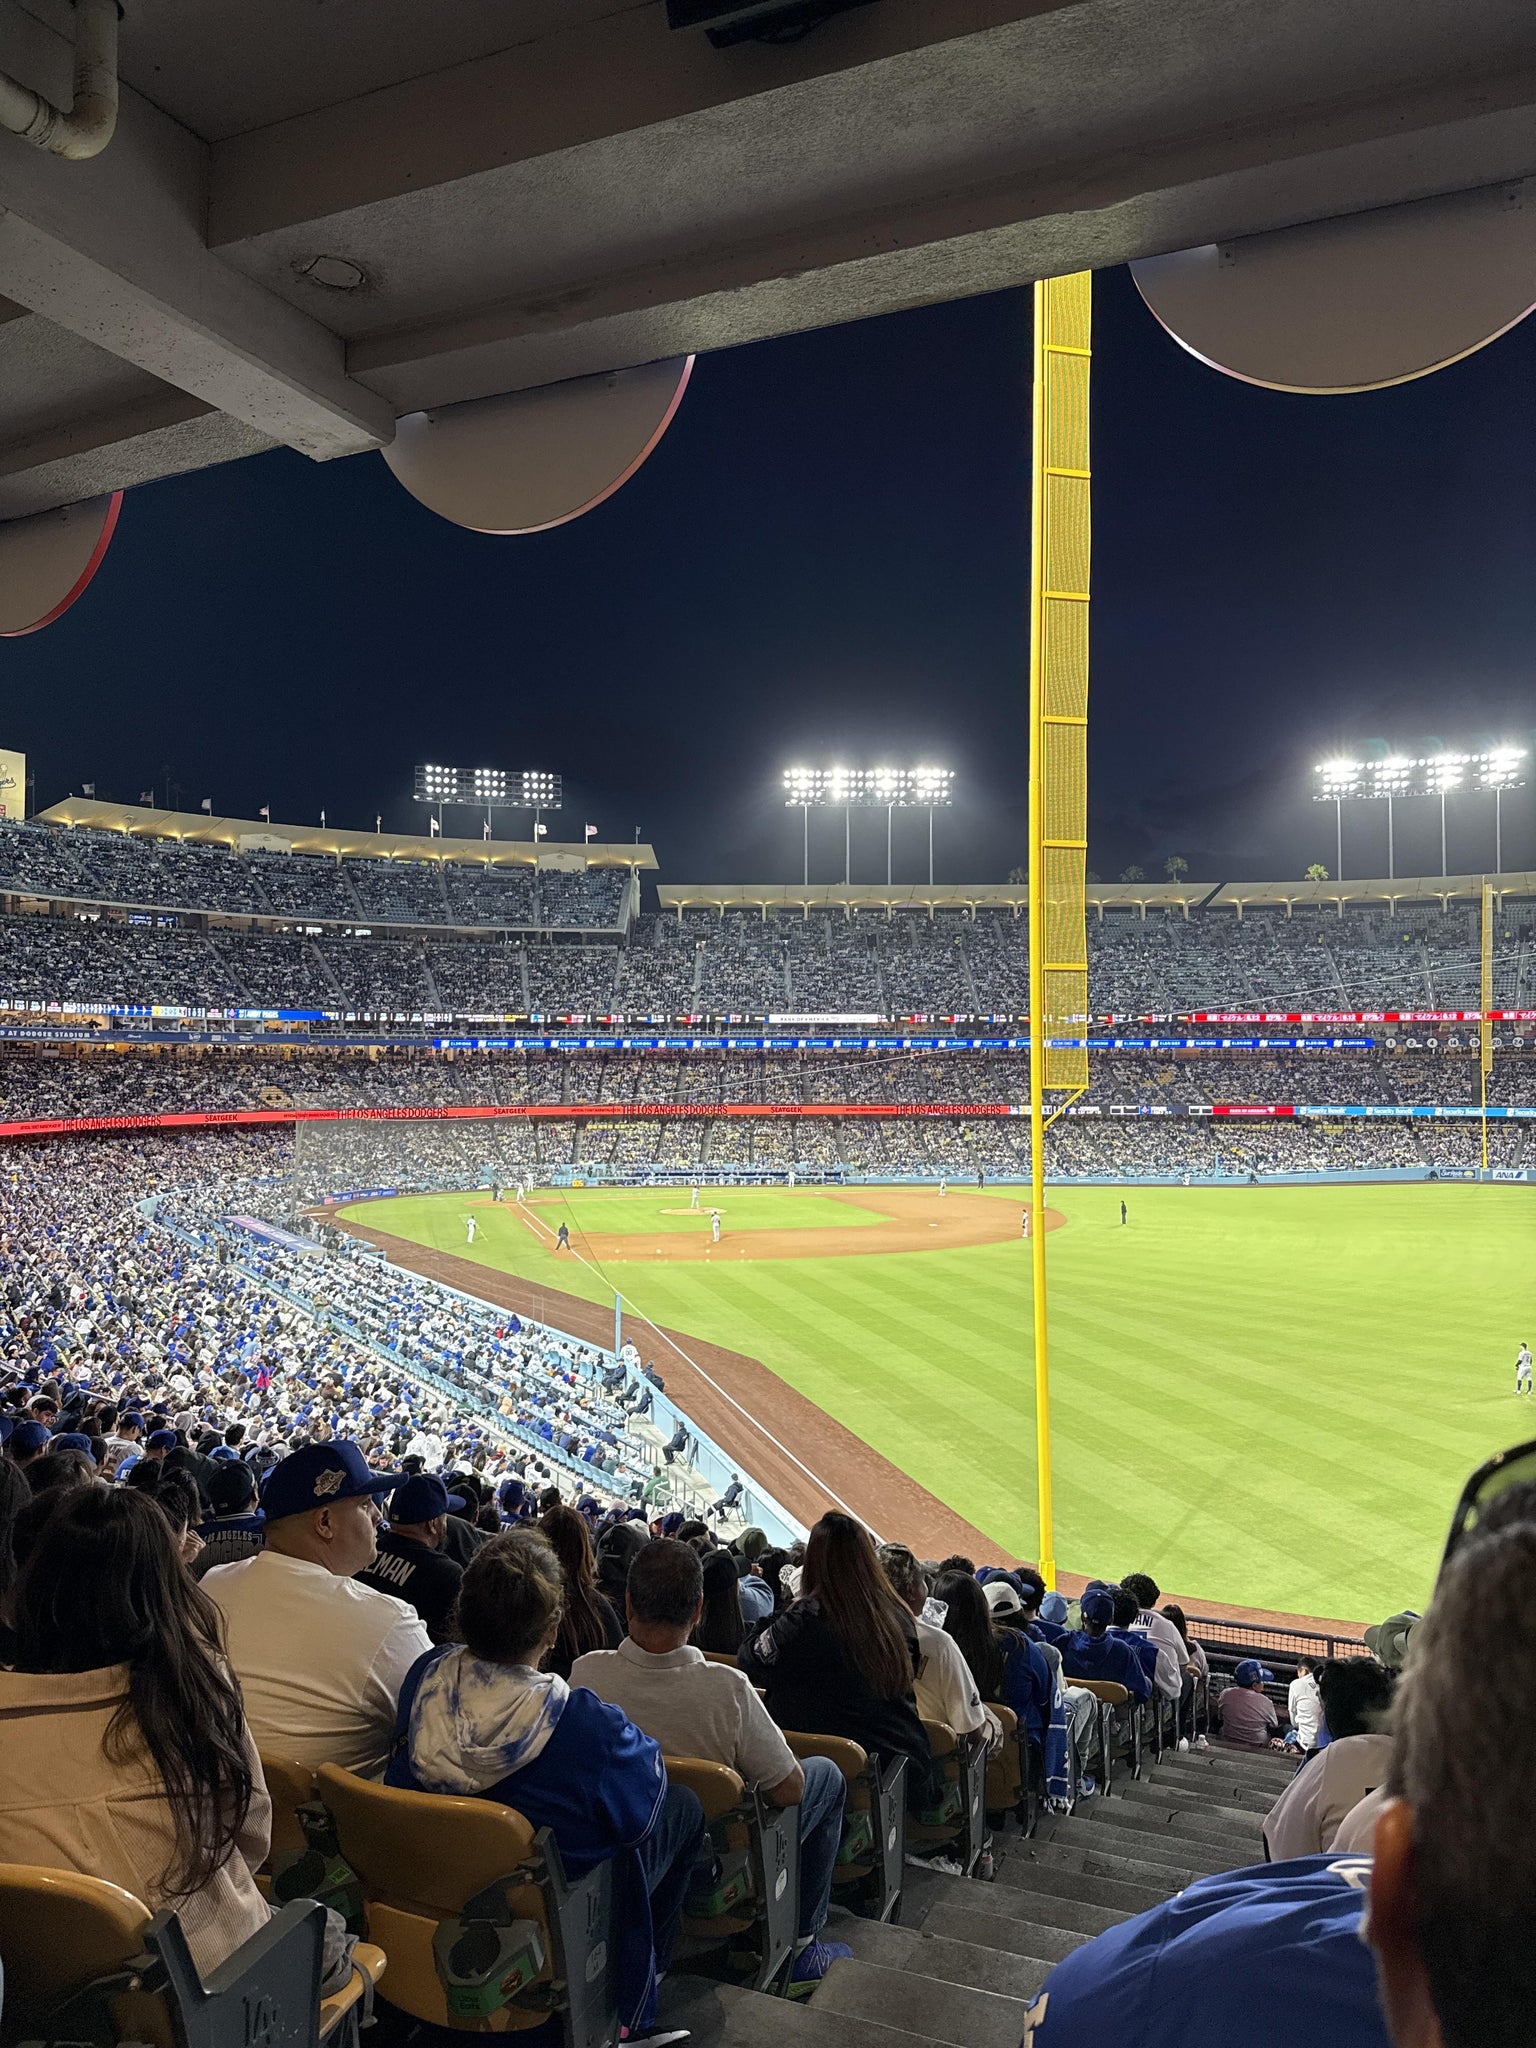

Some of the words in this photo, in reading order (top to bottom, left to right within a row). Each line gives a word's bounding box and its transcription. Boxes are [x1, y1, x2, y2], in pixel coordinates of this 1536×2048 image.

[338, 1109, 351, 1119] THE
[353, 1109, 368, 1119] LOS
[371, 1108, 407, 1119] ANGELES
[408, 1107, 448, 1118] DODGERS
[494, 1107, 527, 1115] SEATGEEK
[623, 1105, 637, 1115] THE
[638, 1105, 653, 1115] LOS
[655, 1105, 689, 1115] ANGELES
[690, 1105, 727, 1115] DODGERS
[896, 1105, 911, 1115] THE
[911, 1105, 926, 1115] LOS
[928, 1105, 962, 1115] ANGELES
[963, 1105, 1001, 1115] DODGERS
[62, 1118, 75, 1129] THE
[76, 1118, 89, 1129] LOS
[91, 1117, 123, 1129] ANGELES
[124, 1115, 161, 1127] DODGERS
[205, 1114, 238, 1122] SEATGEEK
[1495, 1171, 1514, 1179] ANA
[216, 1530, 253, 1541] ANGELES
